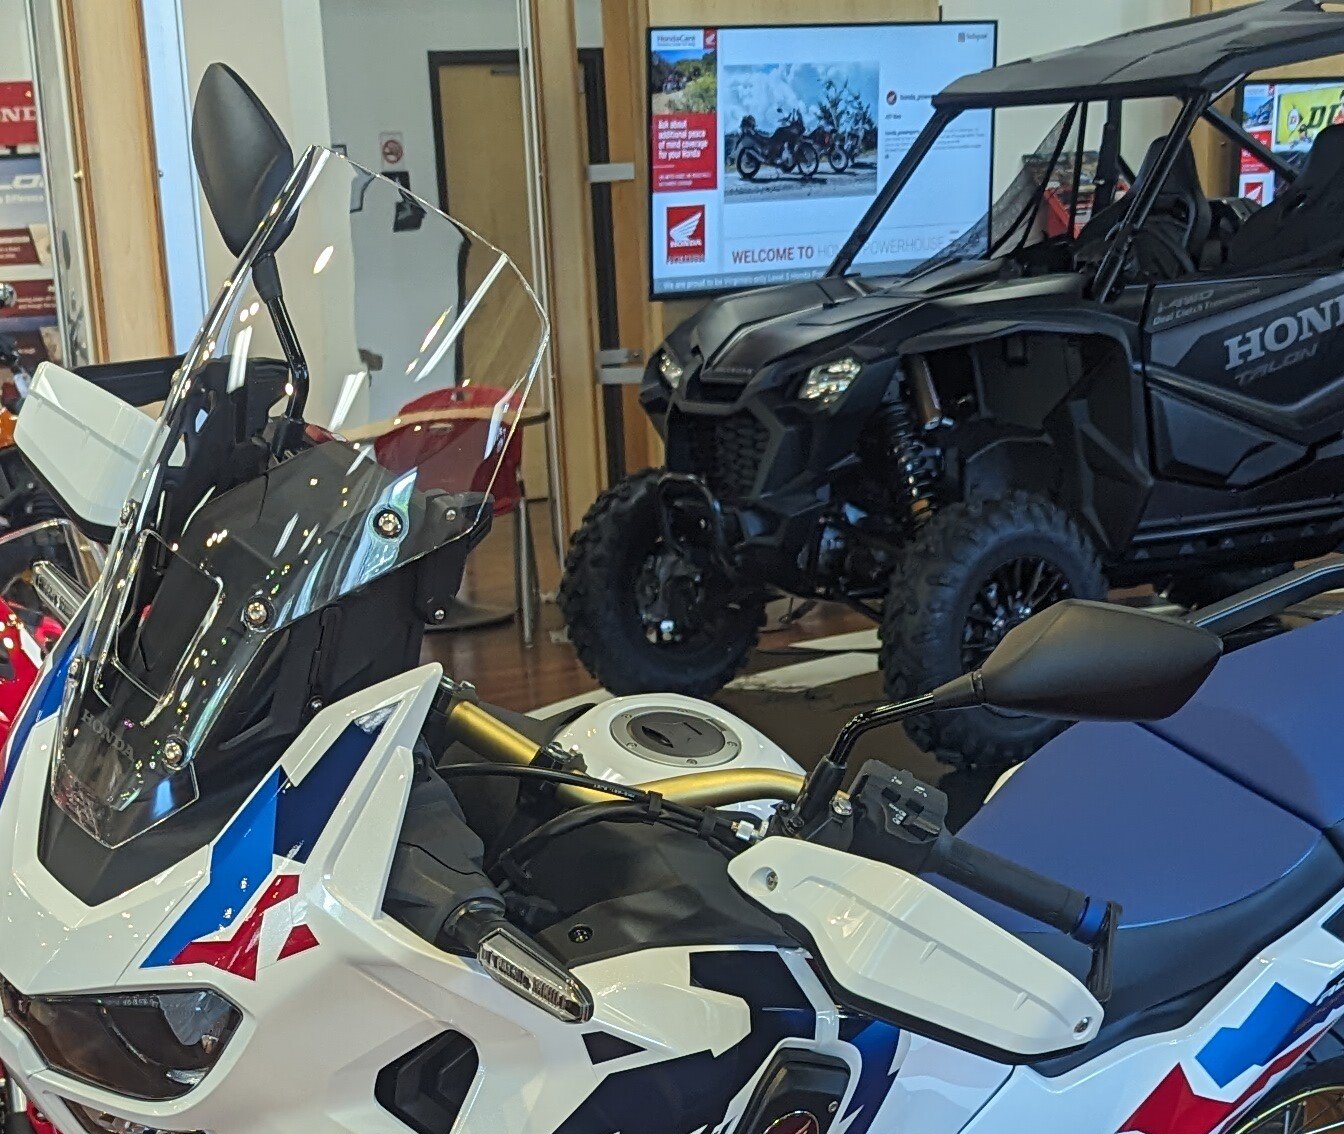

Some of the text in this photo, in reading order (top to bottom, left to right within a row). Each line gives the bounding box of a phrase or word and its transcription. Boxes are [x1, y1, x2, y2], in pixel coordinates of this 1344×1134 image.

[732, 247, 795, 265] WELCOME
[797, 245, 815, 260] TO
[81, 708, 135, 764] HONDA
